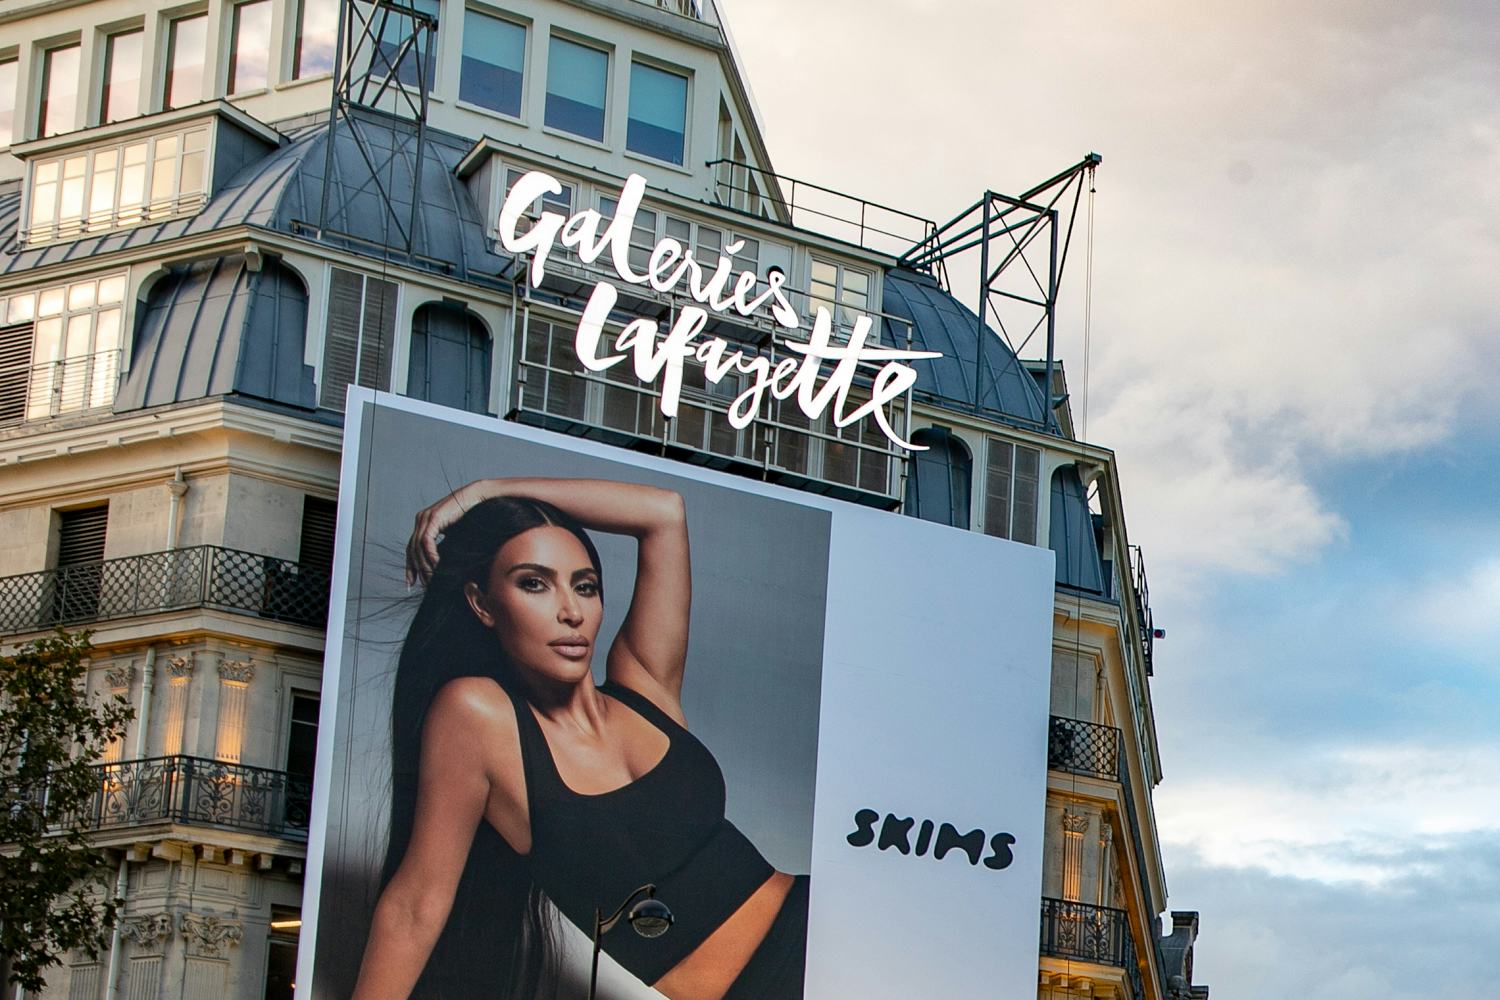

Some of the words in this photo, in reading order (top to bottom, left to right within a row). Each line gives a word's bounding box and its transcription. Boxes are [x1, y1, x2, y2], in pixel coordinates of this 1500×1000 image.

[499, 171, 800, 329] Galeries
[574, 281, 943, 452] Lafayette
[846, 808, 1016, 870] SKIMS
